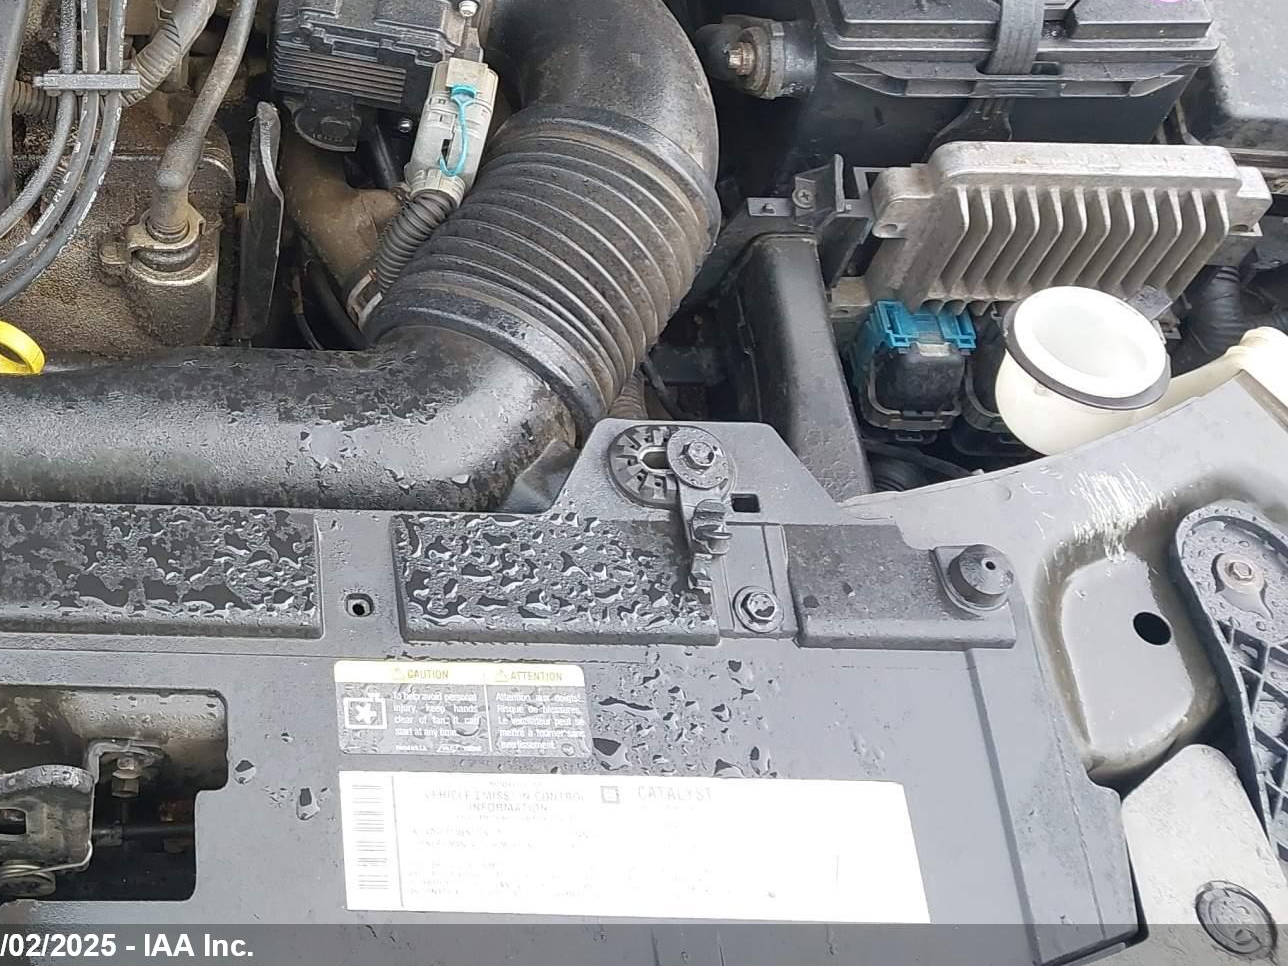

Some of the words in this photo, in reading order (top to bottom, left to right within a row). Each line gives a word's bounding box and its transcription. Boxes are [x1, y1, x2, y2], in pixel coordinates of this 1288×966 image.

[407, 669, 449, 679] CAUTION
[511, 671, 563, 681] ATTENTION
[475, 789, 531, 801] EMISSN
[637, 786, 713, 801] CATALYST
